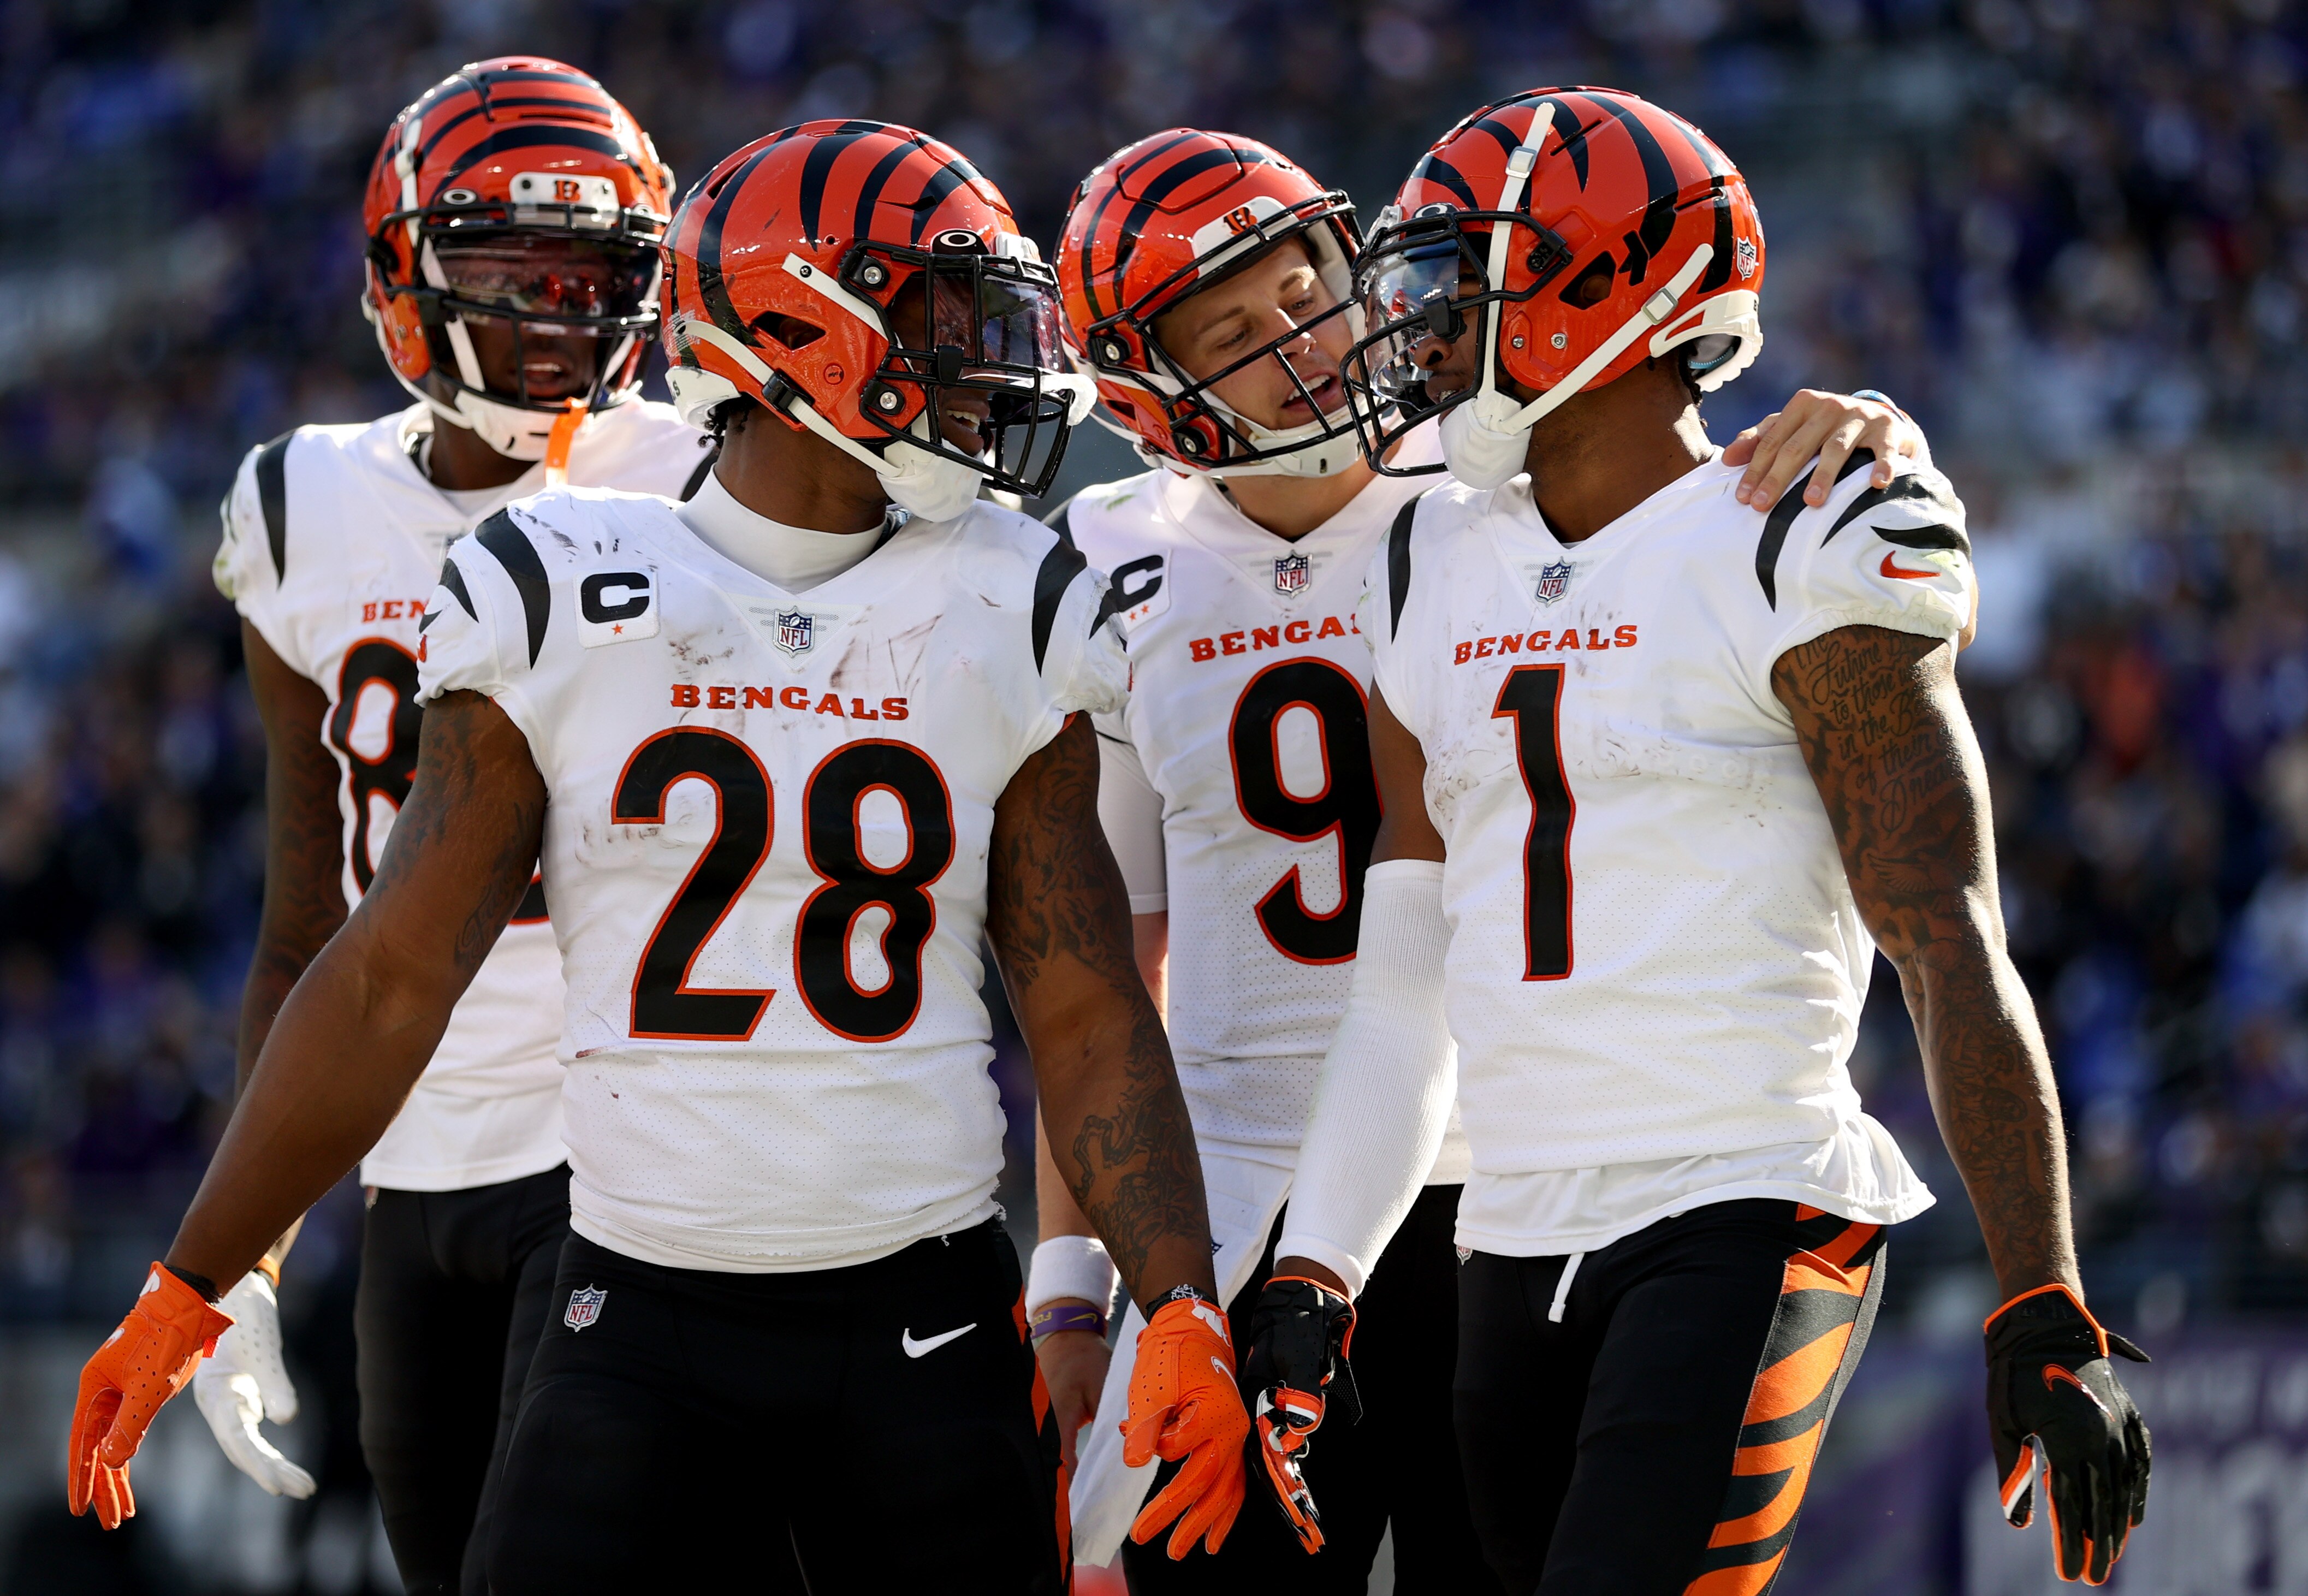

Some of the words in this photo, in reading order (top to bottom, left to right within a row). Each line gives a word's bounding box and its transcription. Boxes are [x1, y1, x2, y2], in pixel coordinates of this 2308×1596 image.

[581, 572, 649, 624] C
[1109, 554, 1164, 612] C
[1278, 569, 1305, 589] NFL
[1540, 579, 1563, 597] NFL
[780, 627, 808, 647] NFL
[1189, 613, 1361, 663] BENGA
[1453, 625, 1638, 665] BENGALS
[671, 684, 909, 721] BENGALS
[1229, 656, 1385, 966] 9
[1491, 663, 1576, 982] 1
[610, 725, 956, 1043] 28
[569, 1304, 593, 1323] NFL
